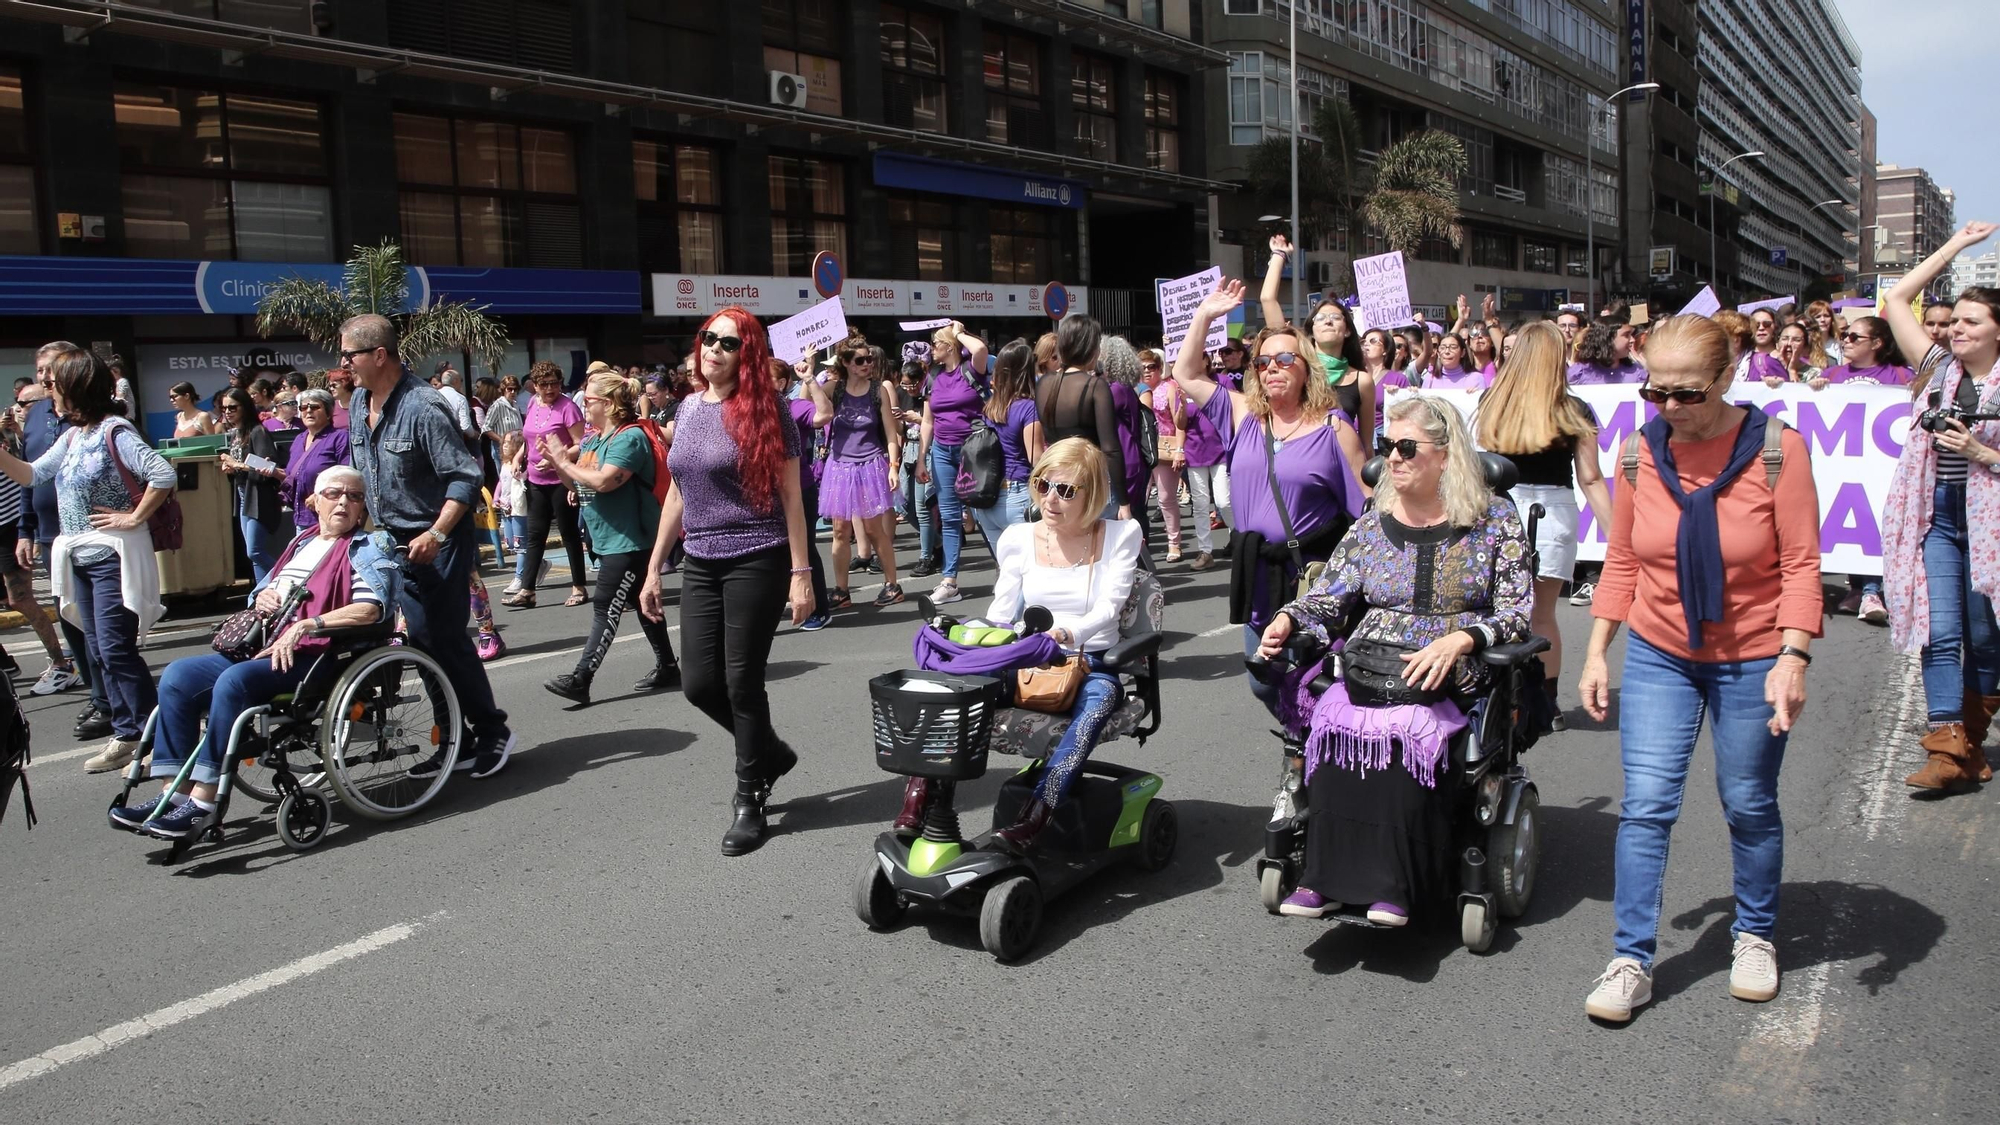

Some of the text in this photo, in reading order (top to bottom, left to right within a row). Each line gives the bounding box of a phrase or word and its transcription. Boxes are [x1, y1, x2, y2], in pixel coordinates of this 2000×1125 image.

[1024, 181, 1057, 200] Allianz
[1356, 255, 1401, 278] NUNCA
[713, 283, 759, 298] Inserta
[857, 286, 894, 299] Inserta
[1162, 274, 1215, 297] DESPUÉS DE TODA
[962, 289, 993, 302] Inserta
[1164, 298, 1173, 307] LA
[1203, 288, 1210, 297] DE
[676, 301, 697, 309] ONCE
[1165, 307, 1174, 315] LA
[1363, 297, 1407, 312] NUESTRO
[1366, 304, 1411, 328] SILENCIO
[1432, 308, 1444, 319] CAFE
[795, 319, 829, 339] HOMBRES
[169, 351, 314, 369] ESTA ES TU CLÍNICA
